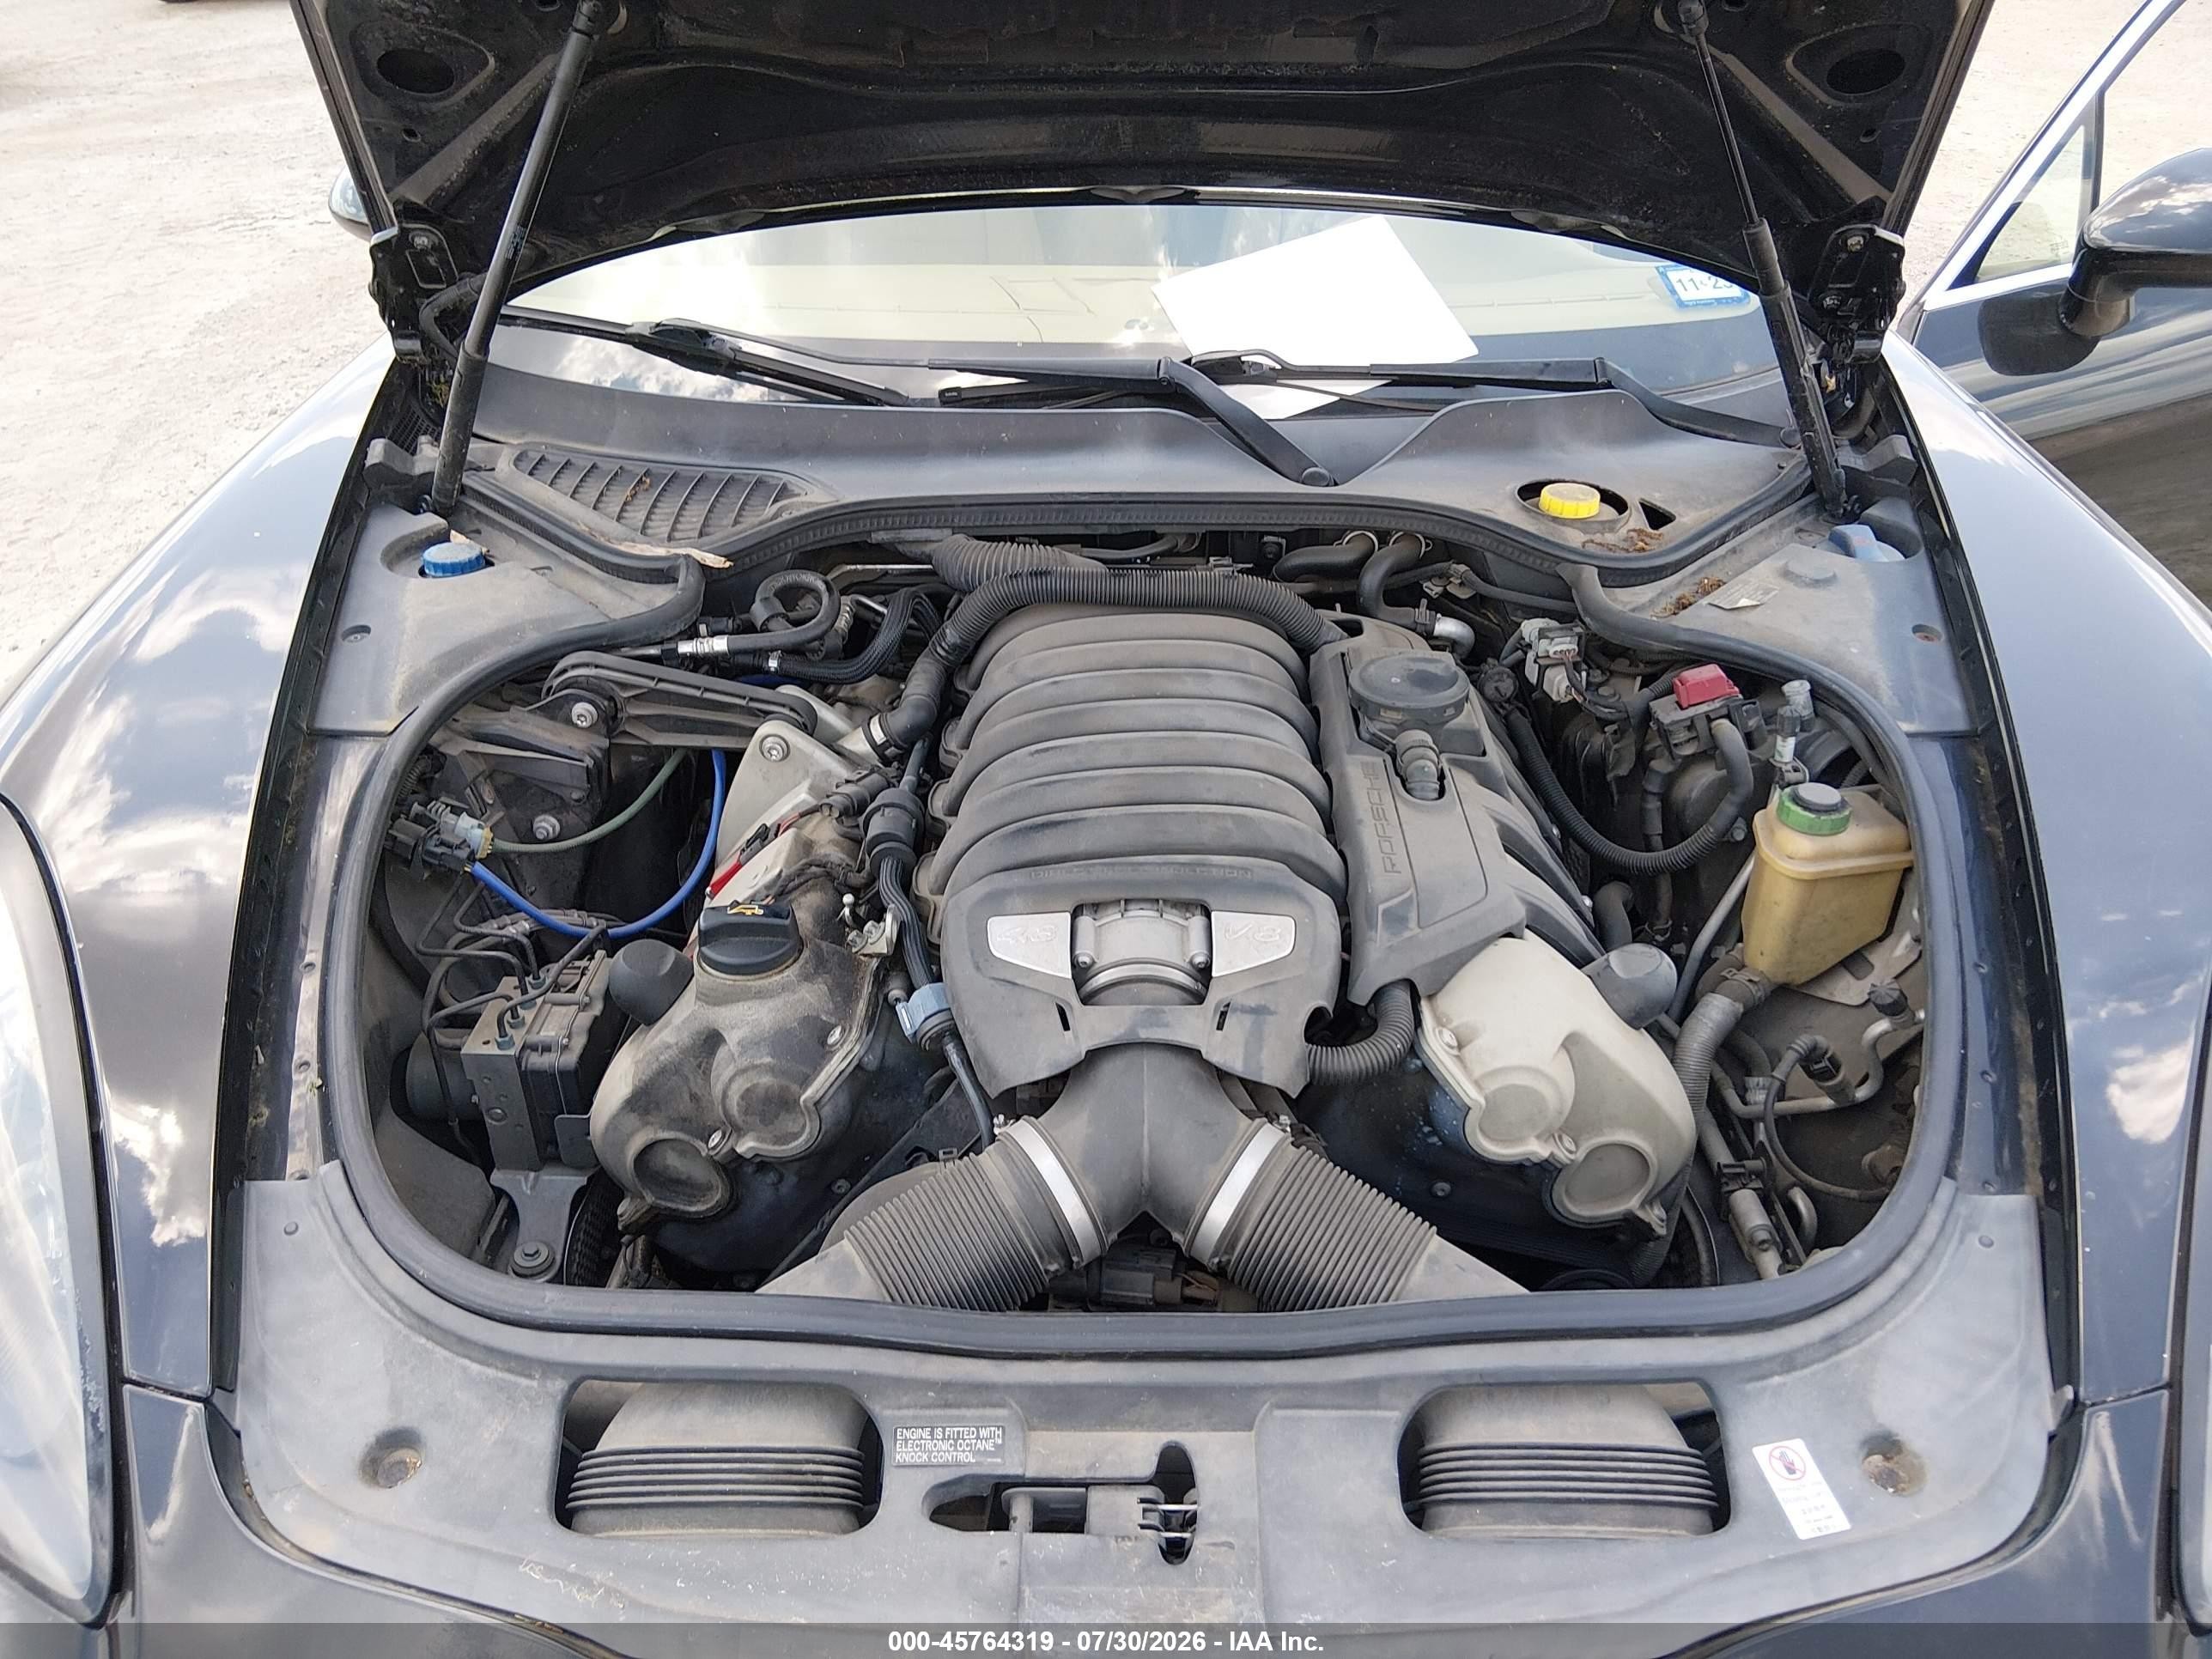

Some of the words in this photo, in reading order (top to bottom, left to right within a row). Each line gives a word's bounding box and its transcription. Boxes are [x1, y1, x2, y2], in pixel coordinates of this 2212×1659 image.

[1360, 761, 1402, 874] PORSCHE
[896, 1427, 932, 1439] ENGINE
[933, 1427, 943, 1439] IS
[945, 1426, 977, 1439] FITTED
[979, 1426, 1002, 1439] WITH
[896, 1439, 955, 1452] ELECTRONIC
[895, 1451, 929, 1463] KNOCK
[931, 1451, 976, 1463] CONTROL
